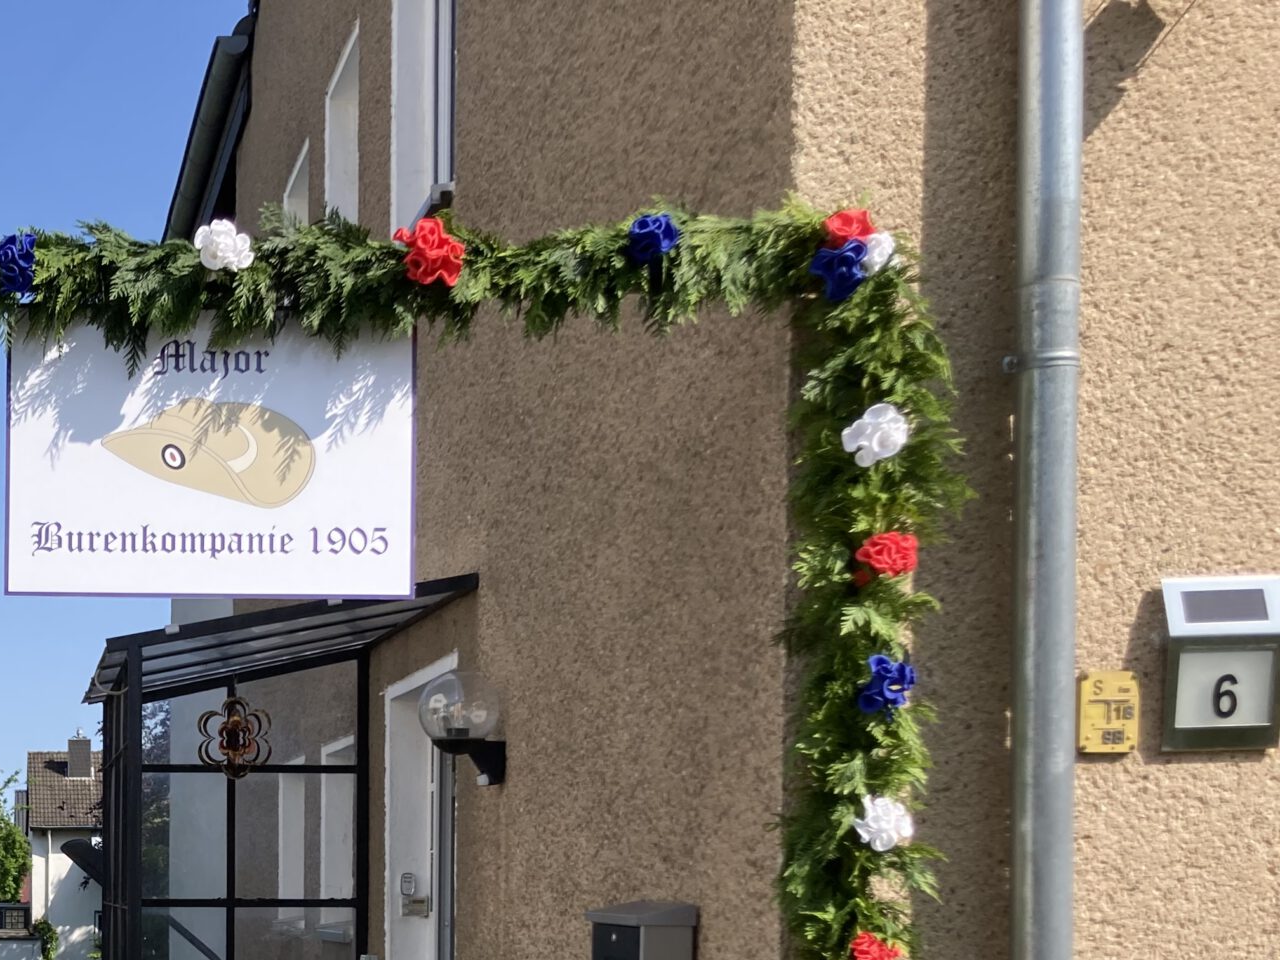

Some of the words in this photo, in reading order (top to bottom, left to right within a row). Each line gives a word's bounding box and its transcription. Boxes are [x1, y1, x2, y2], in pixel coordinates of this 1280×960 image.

[154, 339, 270, 380] Major
[31, 521, 294, 559] Burenkompanie
[310, 526, 389, 555] 1905
[1093, 679, 1103, 696] S
[1213, 673, 1238, 719] 6
